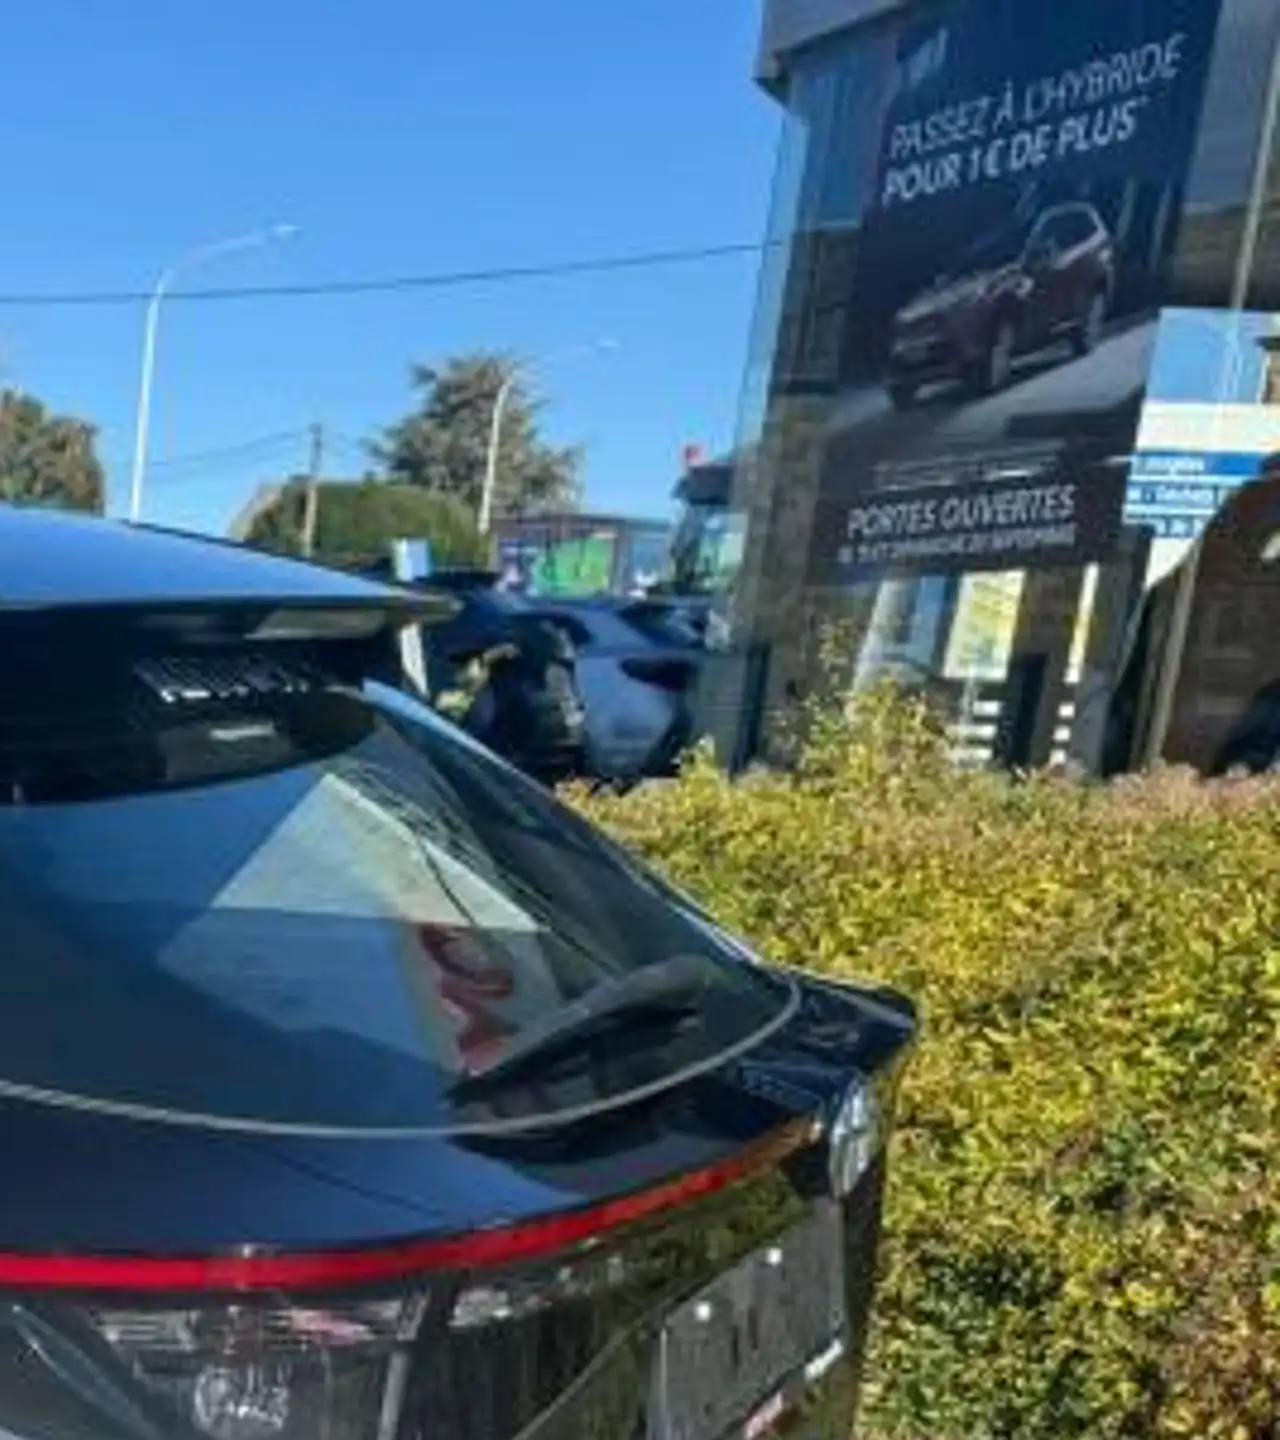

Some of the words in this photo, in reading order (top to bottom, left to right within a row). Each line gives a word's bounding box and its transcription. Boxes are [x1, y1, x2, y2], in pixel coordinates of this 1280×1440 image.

[890, 96, 996, 159] PASSEZ
[1024, 32, 1188, 121] L'HYBRIDE
[882, 152, 961, 205] POUR
[1010, 124, 1052, 171] DE
[846, 501, 937, 539] PORTES
[941, 484, 1077, 530] OUVERTES
